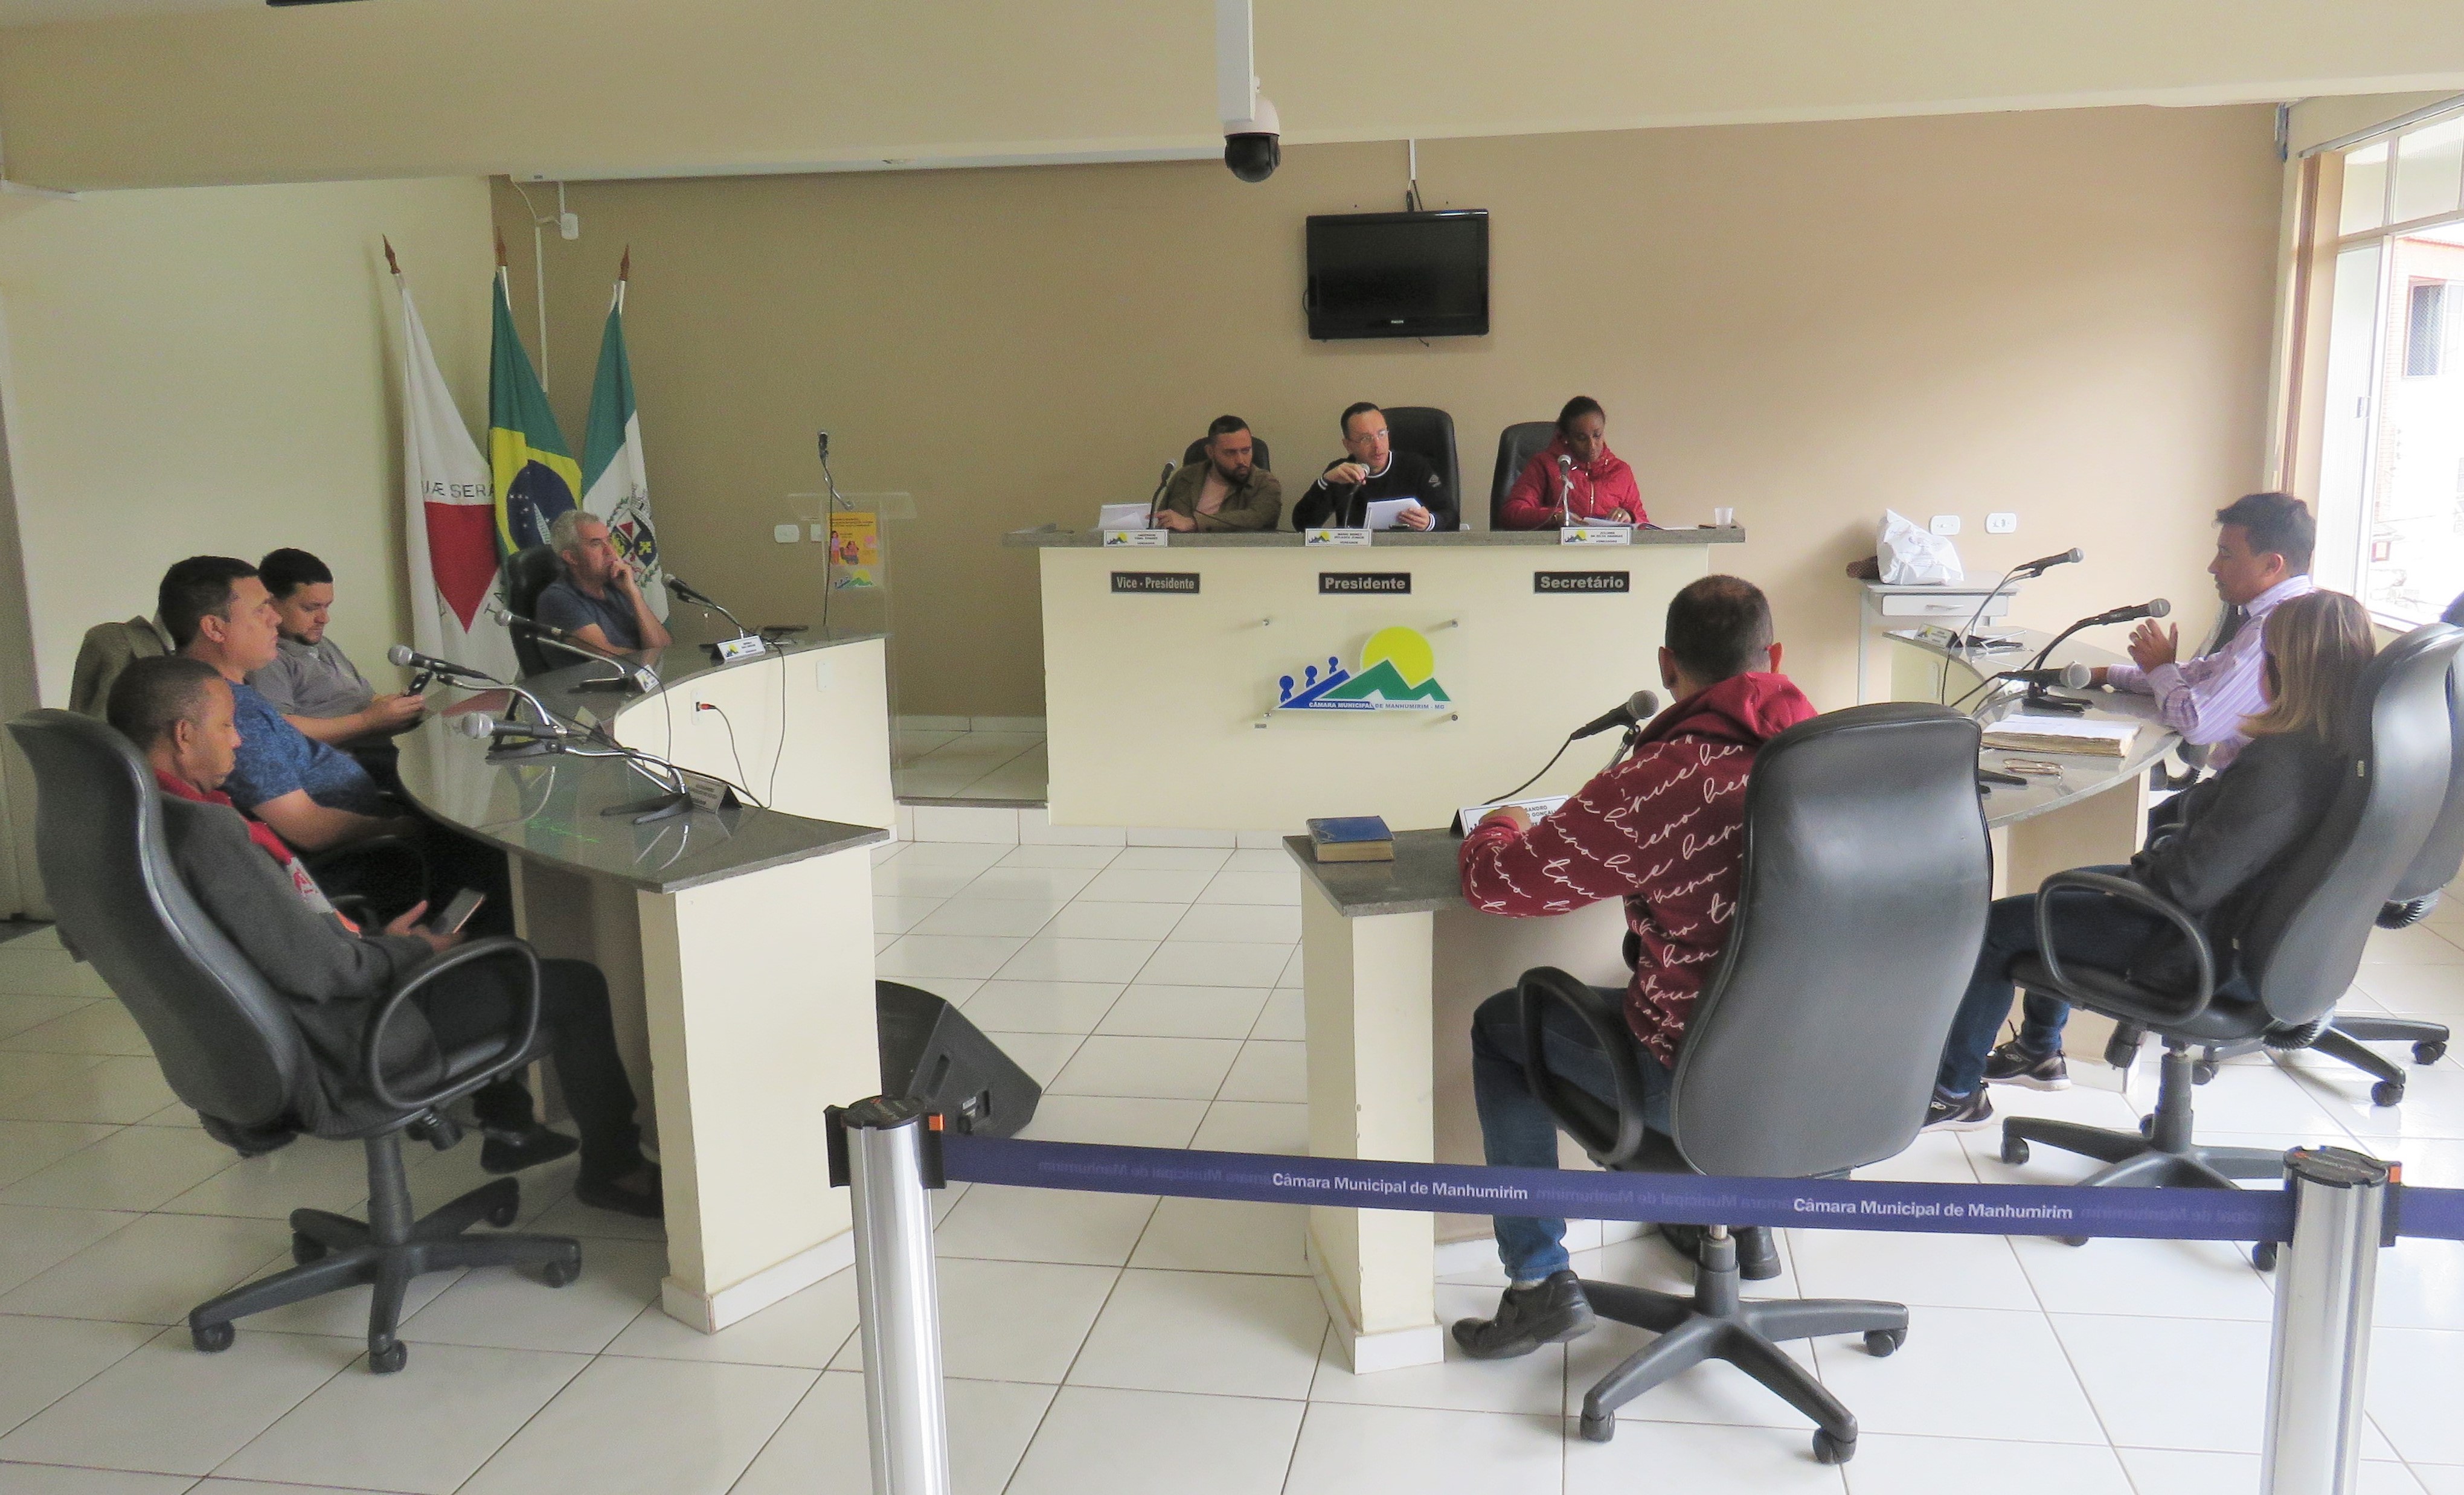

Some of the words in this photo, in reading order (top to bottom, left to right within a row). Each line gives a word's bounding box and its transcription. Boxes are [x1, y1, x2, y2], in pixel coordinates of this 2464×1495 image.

[1117, 576, 1137, 588] Vice
[1145, 577, 1195, 589] Presidente
[1325, 577, 1405, 590] Presidente
[1541, 576, 1624, 589] Secretário
[1309, 700, 1336, 709] CÂMARA
[1272, 1173, 1330, 1189] Câmara
[1334, 1176, 1405, 1196] Municipal
[1410, 1180, 1428, 1194] de
[1432, 1182, 1528, 1200] Manhumirim
[1794, 1198, 1856, 1214] Câmara
[1861, 1200, 1939, 1218] Municipal
[1944, 1203, 1964, 1217] de
[1968, 1203, 2073, 1220] Manhumirim
